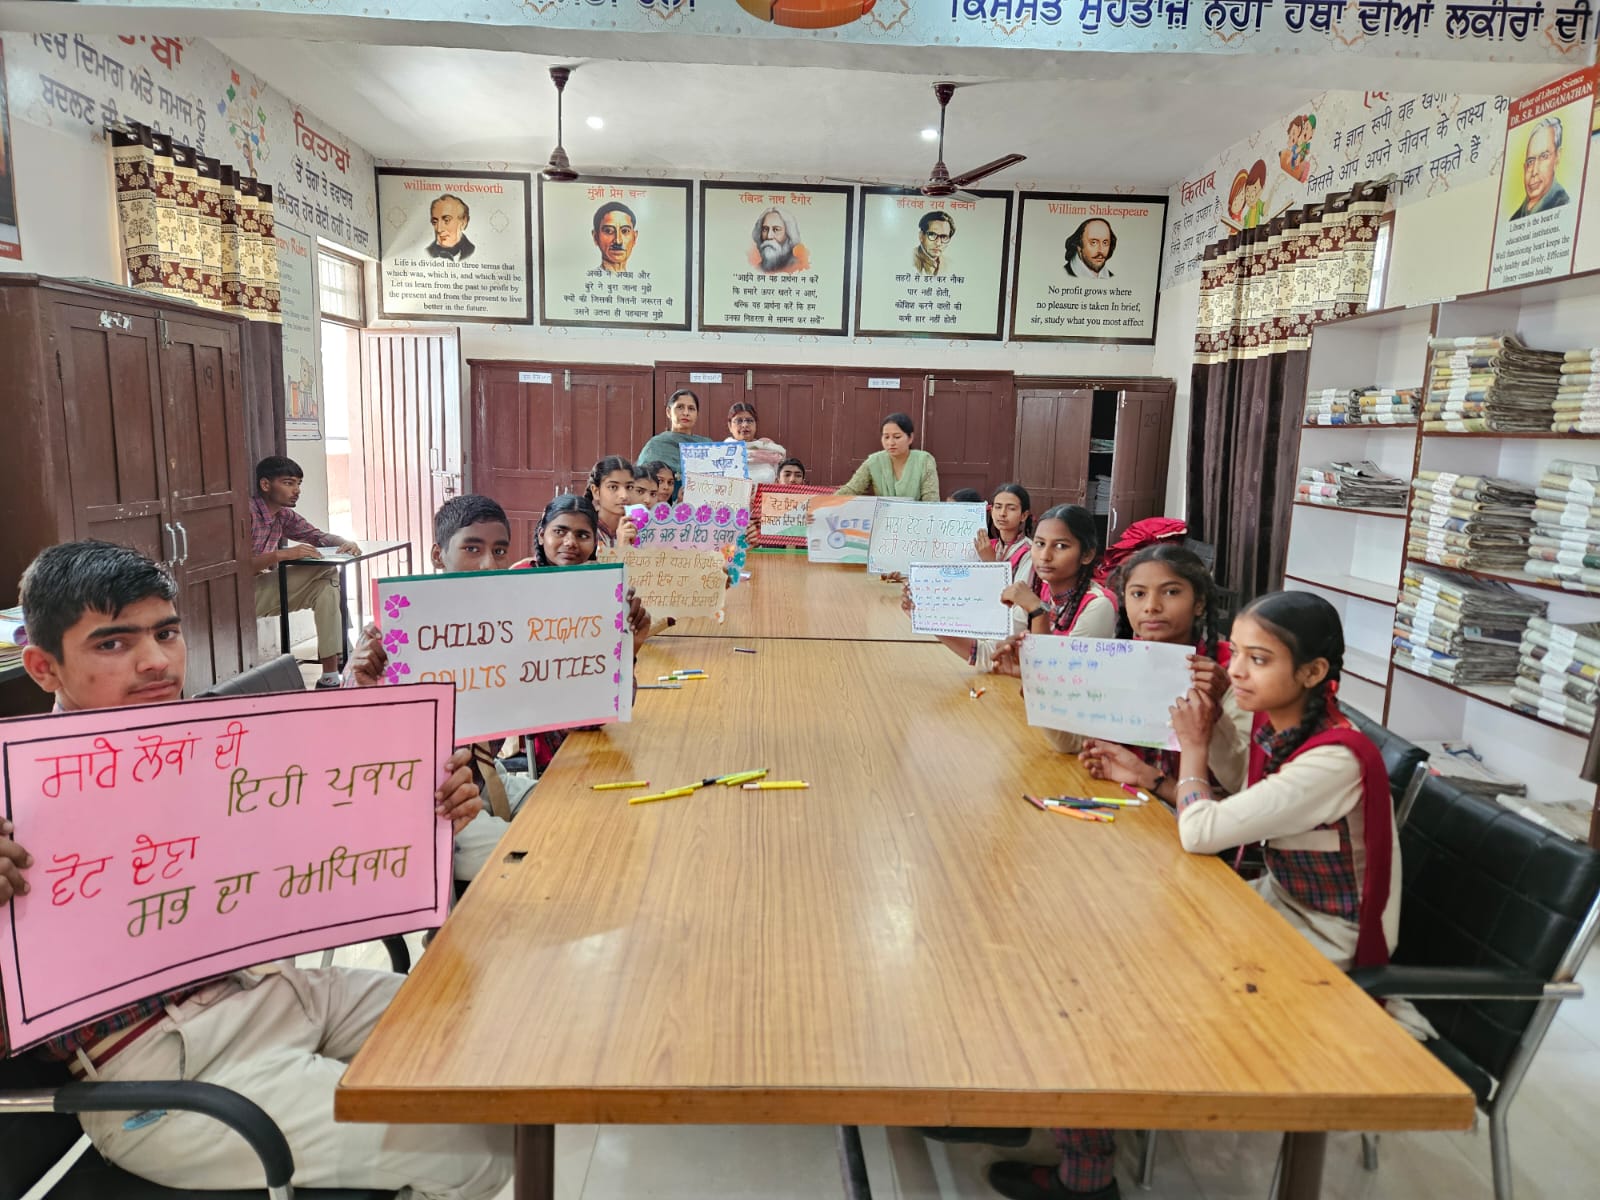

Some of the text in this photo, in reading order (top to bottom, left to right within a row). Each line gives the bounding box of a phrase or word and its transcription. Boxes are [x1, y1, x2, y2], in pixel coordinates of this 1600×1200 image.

[1555, 0, 1593, 41] ਦੀ
[1562, 75, 1585, 90] Science
[39, 73, 96, 125] ਬਦਲਣ
[128, 67, 154, 105] ਅਤੇ
[158, 86, 193, 126] ਸਮਾਜ
[1535, 80, 1593, 116] RANGANATHAN
[1346, 124, 1366, 147] ज्ञान
[1372, 105, 1392, 134] रूपी
[1399, 99, 1415, 121] वह
[293, 111, 350, 174] ਕਿਤਾਬਾਂ
[1307, 165, 1334, 196] जिससे
[1339, 158, 1360, 180] आप
[1365, 138, 1392, 169] अपने
[1398, 127, 1430, 154] जीवन
[1437, 113, 1450, 139] के
[1457, 101, 1487, 131] लक्ष्य
[1403, 165, 1423, 188] कर
[1430, 143, 1463, 178] सकते
[1470, 135, 1481, 163] हैं
[444, 182, 503, 193] wordsworth
[1181, 170, 1216, 207] किताब
[768, 195, 786, 204] नाथ
[930, 201, 945, 209] राय
[1048, 203, 1149, 219] William Shakespeare
[462, 261, 479, 269] three
[410, 270, 426, 278] was,
[428, 271, 451, 279] which
[475, 272, 496, 280] which
[638, 269, 650, 279] और
[757, 275, 766, 283] हम
[415, 280, 432, 288] learn
[434, 281, 451, 289] from
[453, 282, 463, 290] the
[465, 283, 479, 291] past
[511, 283, 519, 293] by
[908, 288, 918, 296] पार
[1048, 286, 1132, 297] No profit grows where
[429, 291, 441, 299] and
[443, 292, 460, 300] from
[474, 294, 498, 302] present
[509, 294, 522, 302] live
[466, 304, 488, 312] future.
[1048, 301, 1079, 311] pleasure
[1081, 301, 1087, 310] is
[1089, 302, 1109, 310] taken
[1121, 302, 1141, 312] brief,
[1031, 315, 1043, 324] sir,
[1045, 315, 1065, 326] study
[1067, 316, 1085, 324] what
[1087, 318, 1100, 327] you
[1123, 317, 1144, 326] affect
[825, 515, 871, 532] VOTE
[680, 524, 692, 542] ਦੀ
[417, 615, 602, 651] CHILD'S RIGHTS
[519, 654, 606, 683] DUTIES
[34, 721, 249, 799] ਸਾਰੇ ਲੋਕਾਂ ਦੀ
[227, 759, 423, 816] ਇਹੀ ਪੁਕਾਰ
[44, 834, 201, 906] ਵੋਟ ਦੇਣਾ
[127, 845, 412, 938] ਸਭ ਦਾ ਅਧਿਕਾਰ
